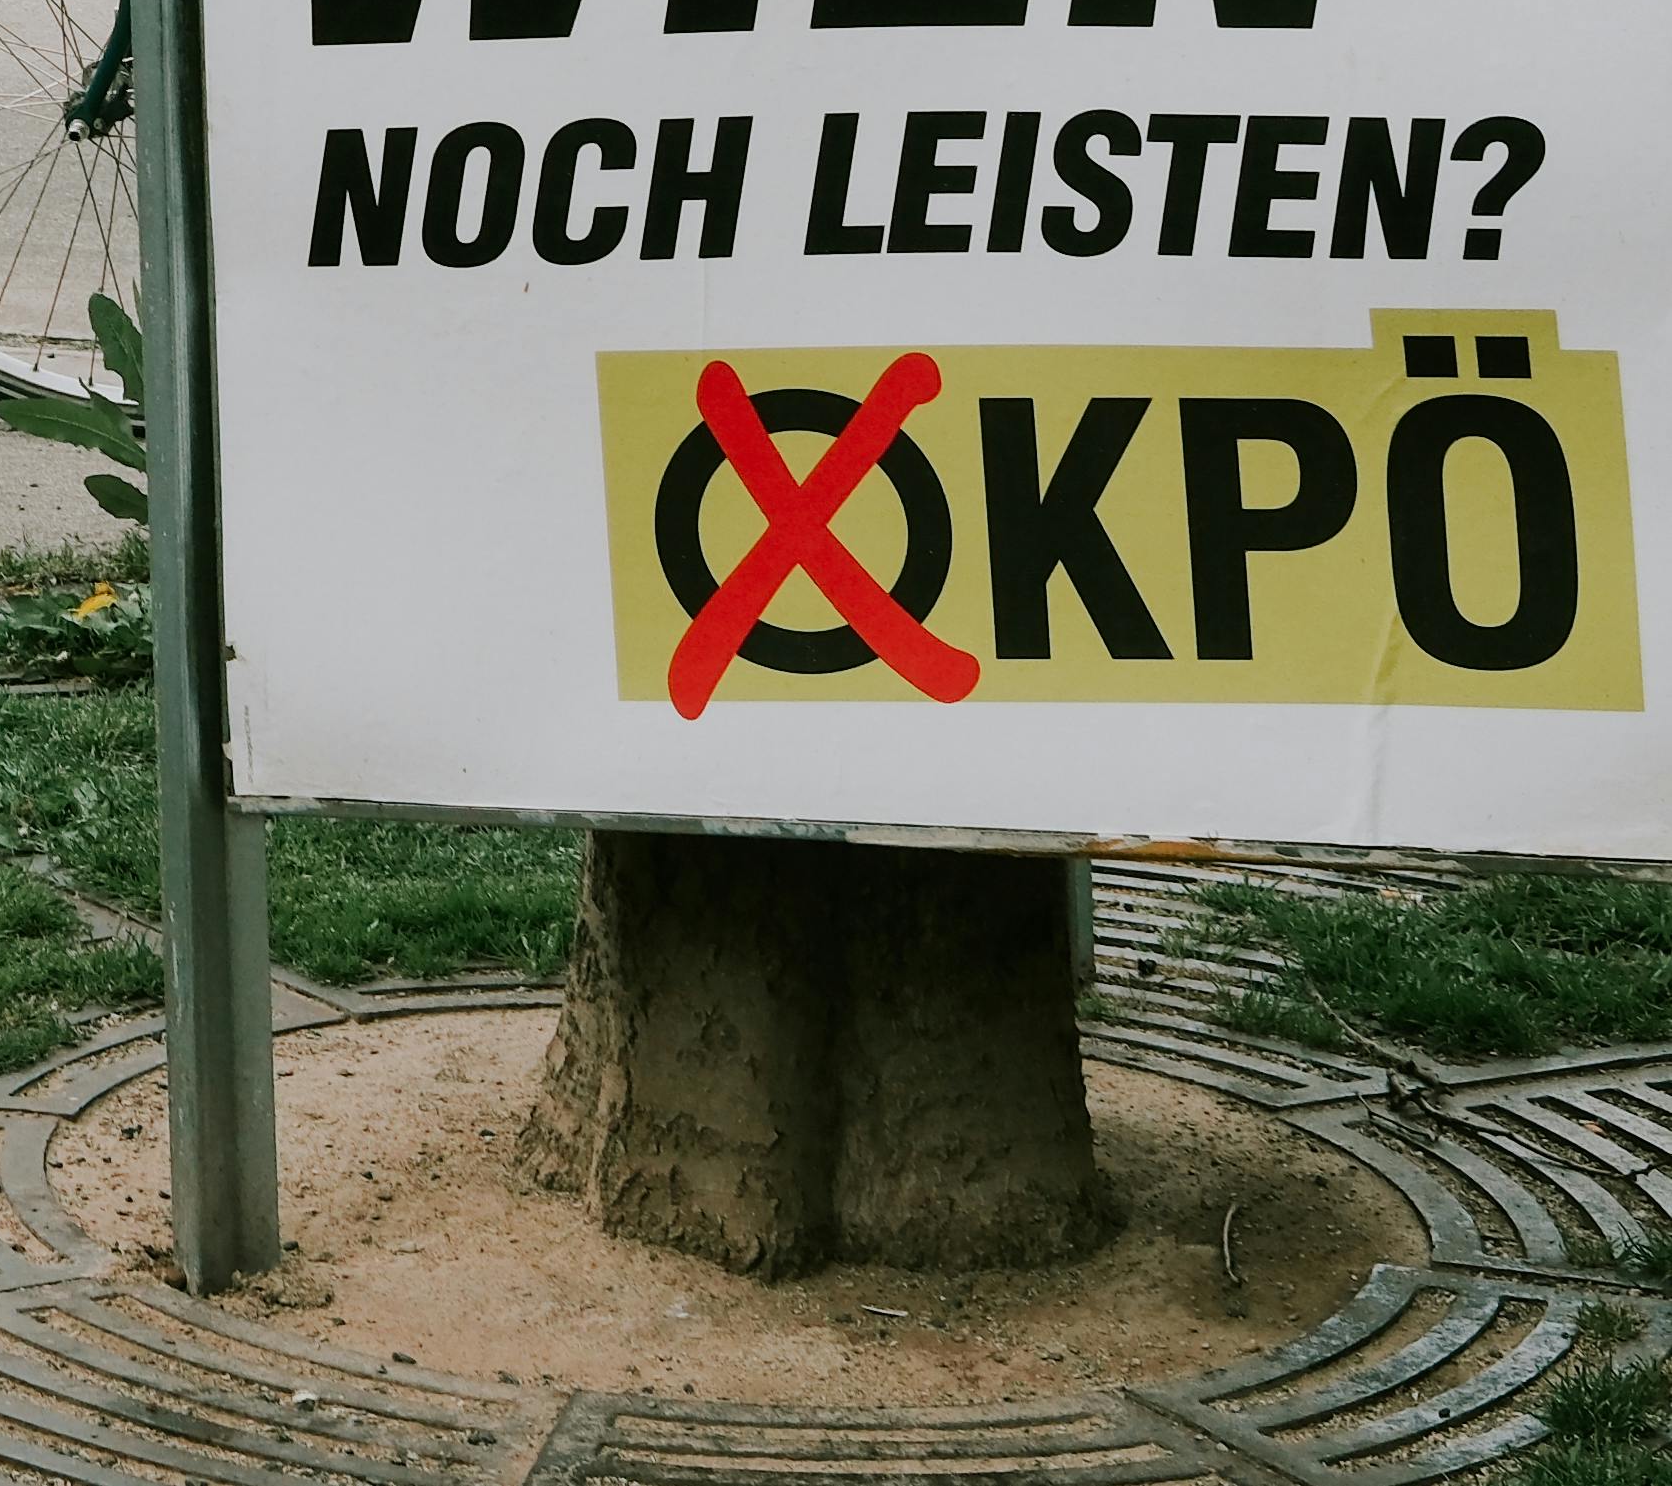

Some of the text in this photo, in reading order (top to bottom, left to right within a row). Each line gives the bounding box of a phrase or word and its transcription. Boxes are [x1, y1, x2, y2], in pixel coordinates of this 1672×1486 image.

[305, 108, 1548, 270] NOCH LEISTEN?
[975, 334, 1582, 674] KPÖ
